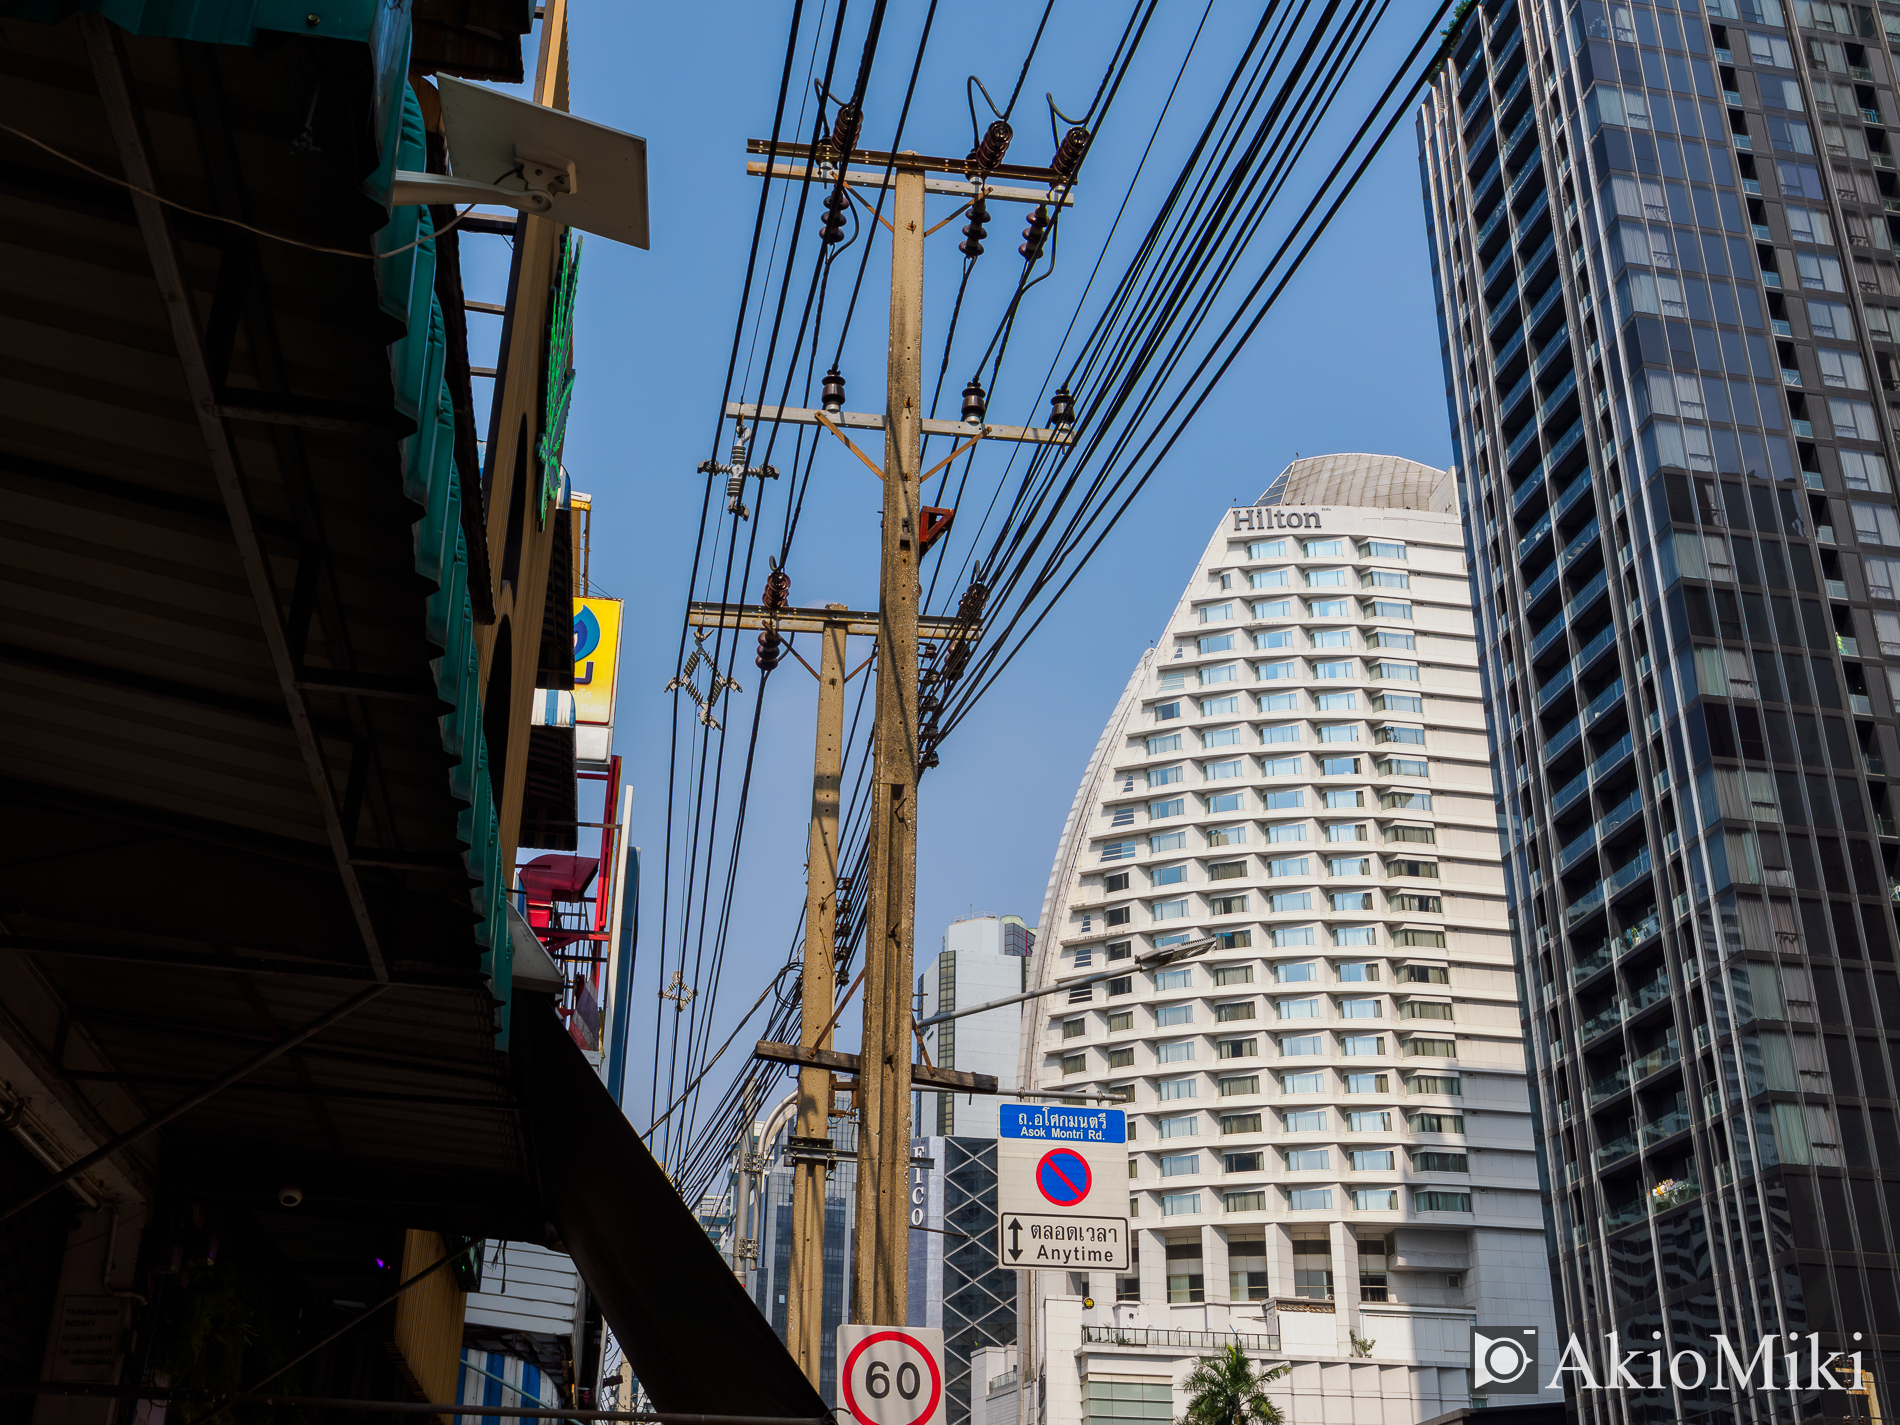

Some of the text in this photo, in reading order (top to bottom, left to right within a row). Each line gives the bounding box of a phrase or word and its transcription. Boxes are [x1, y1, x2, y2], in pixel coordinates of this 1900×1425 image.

[1233, 508, 1322, 531] Hilton
[581, 703, 607, 714] GAS
[1018, 1106, 1107, 1130] ถ.อโศกมนตรี
[1020, 1126, 1106, 1141] Asok Montri Rd.
[1031, 1224, 1118, 1243] ตลอดเวลา
[1037, 1244, 1114, 1264] Anytime
[865, 1361, 920, 1400] 60
